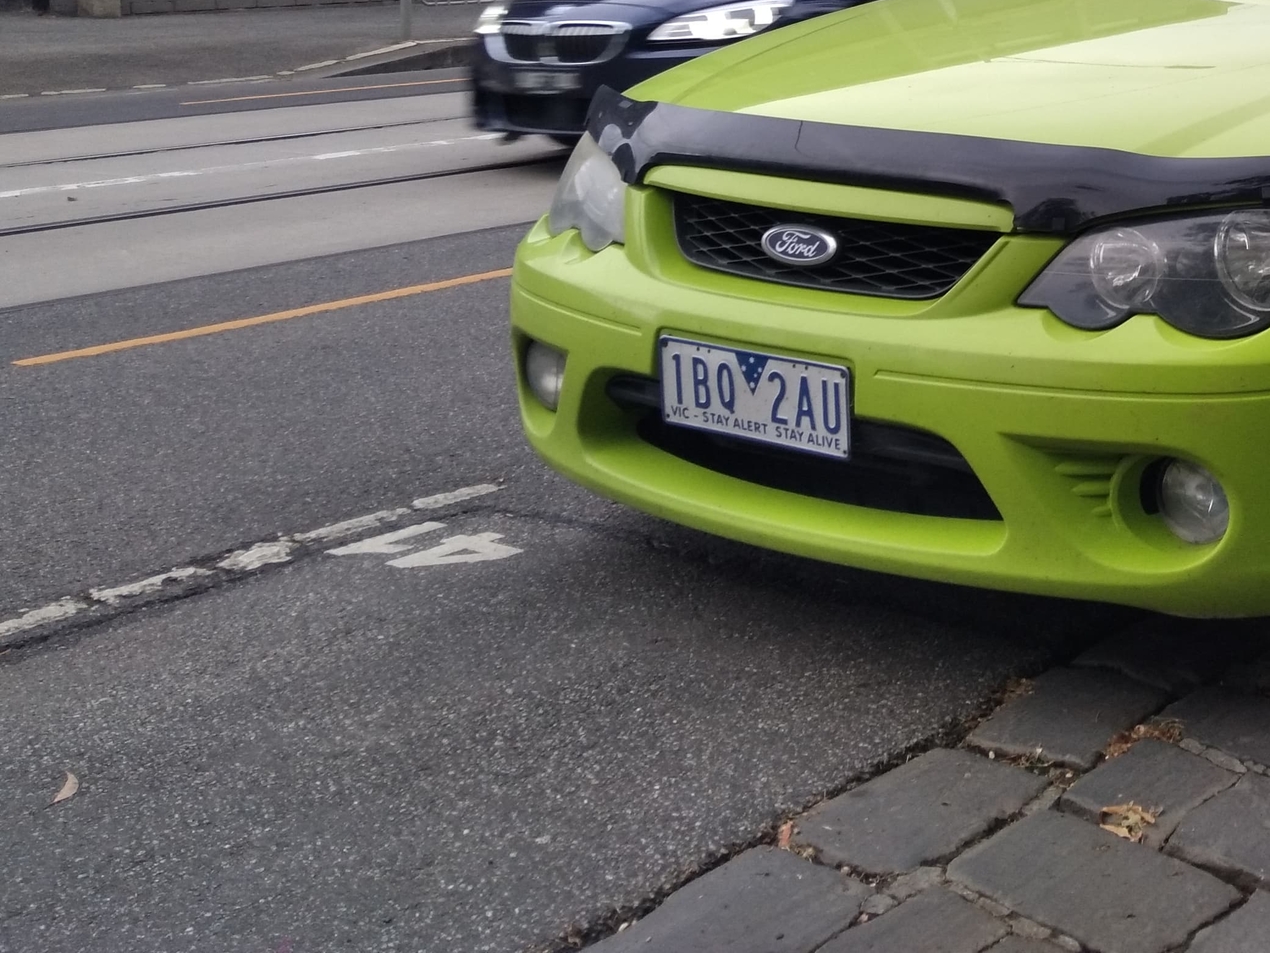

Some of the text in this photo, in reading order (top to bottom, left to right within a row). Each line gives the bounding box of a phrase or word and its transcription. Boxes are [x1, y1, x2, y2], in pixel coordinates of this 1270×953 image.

[775, 230, 820, 257] Ford
[671, 351, 841, 435] 1BQ 2AU
[670, 405, 690, 420] VIC
[702, 411, 731, 427] STAY
[733, 417, 768, 435] ALERT
[775, 426, 804, 443] STAY
[806, 432, 841, 451] ALIVE
